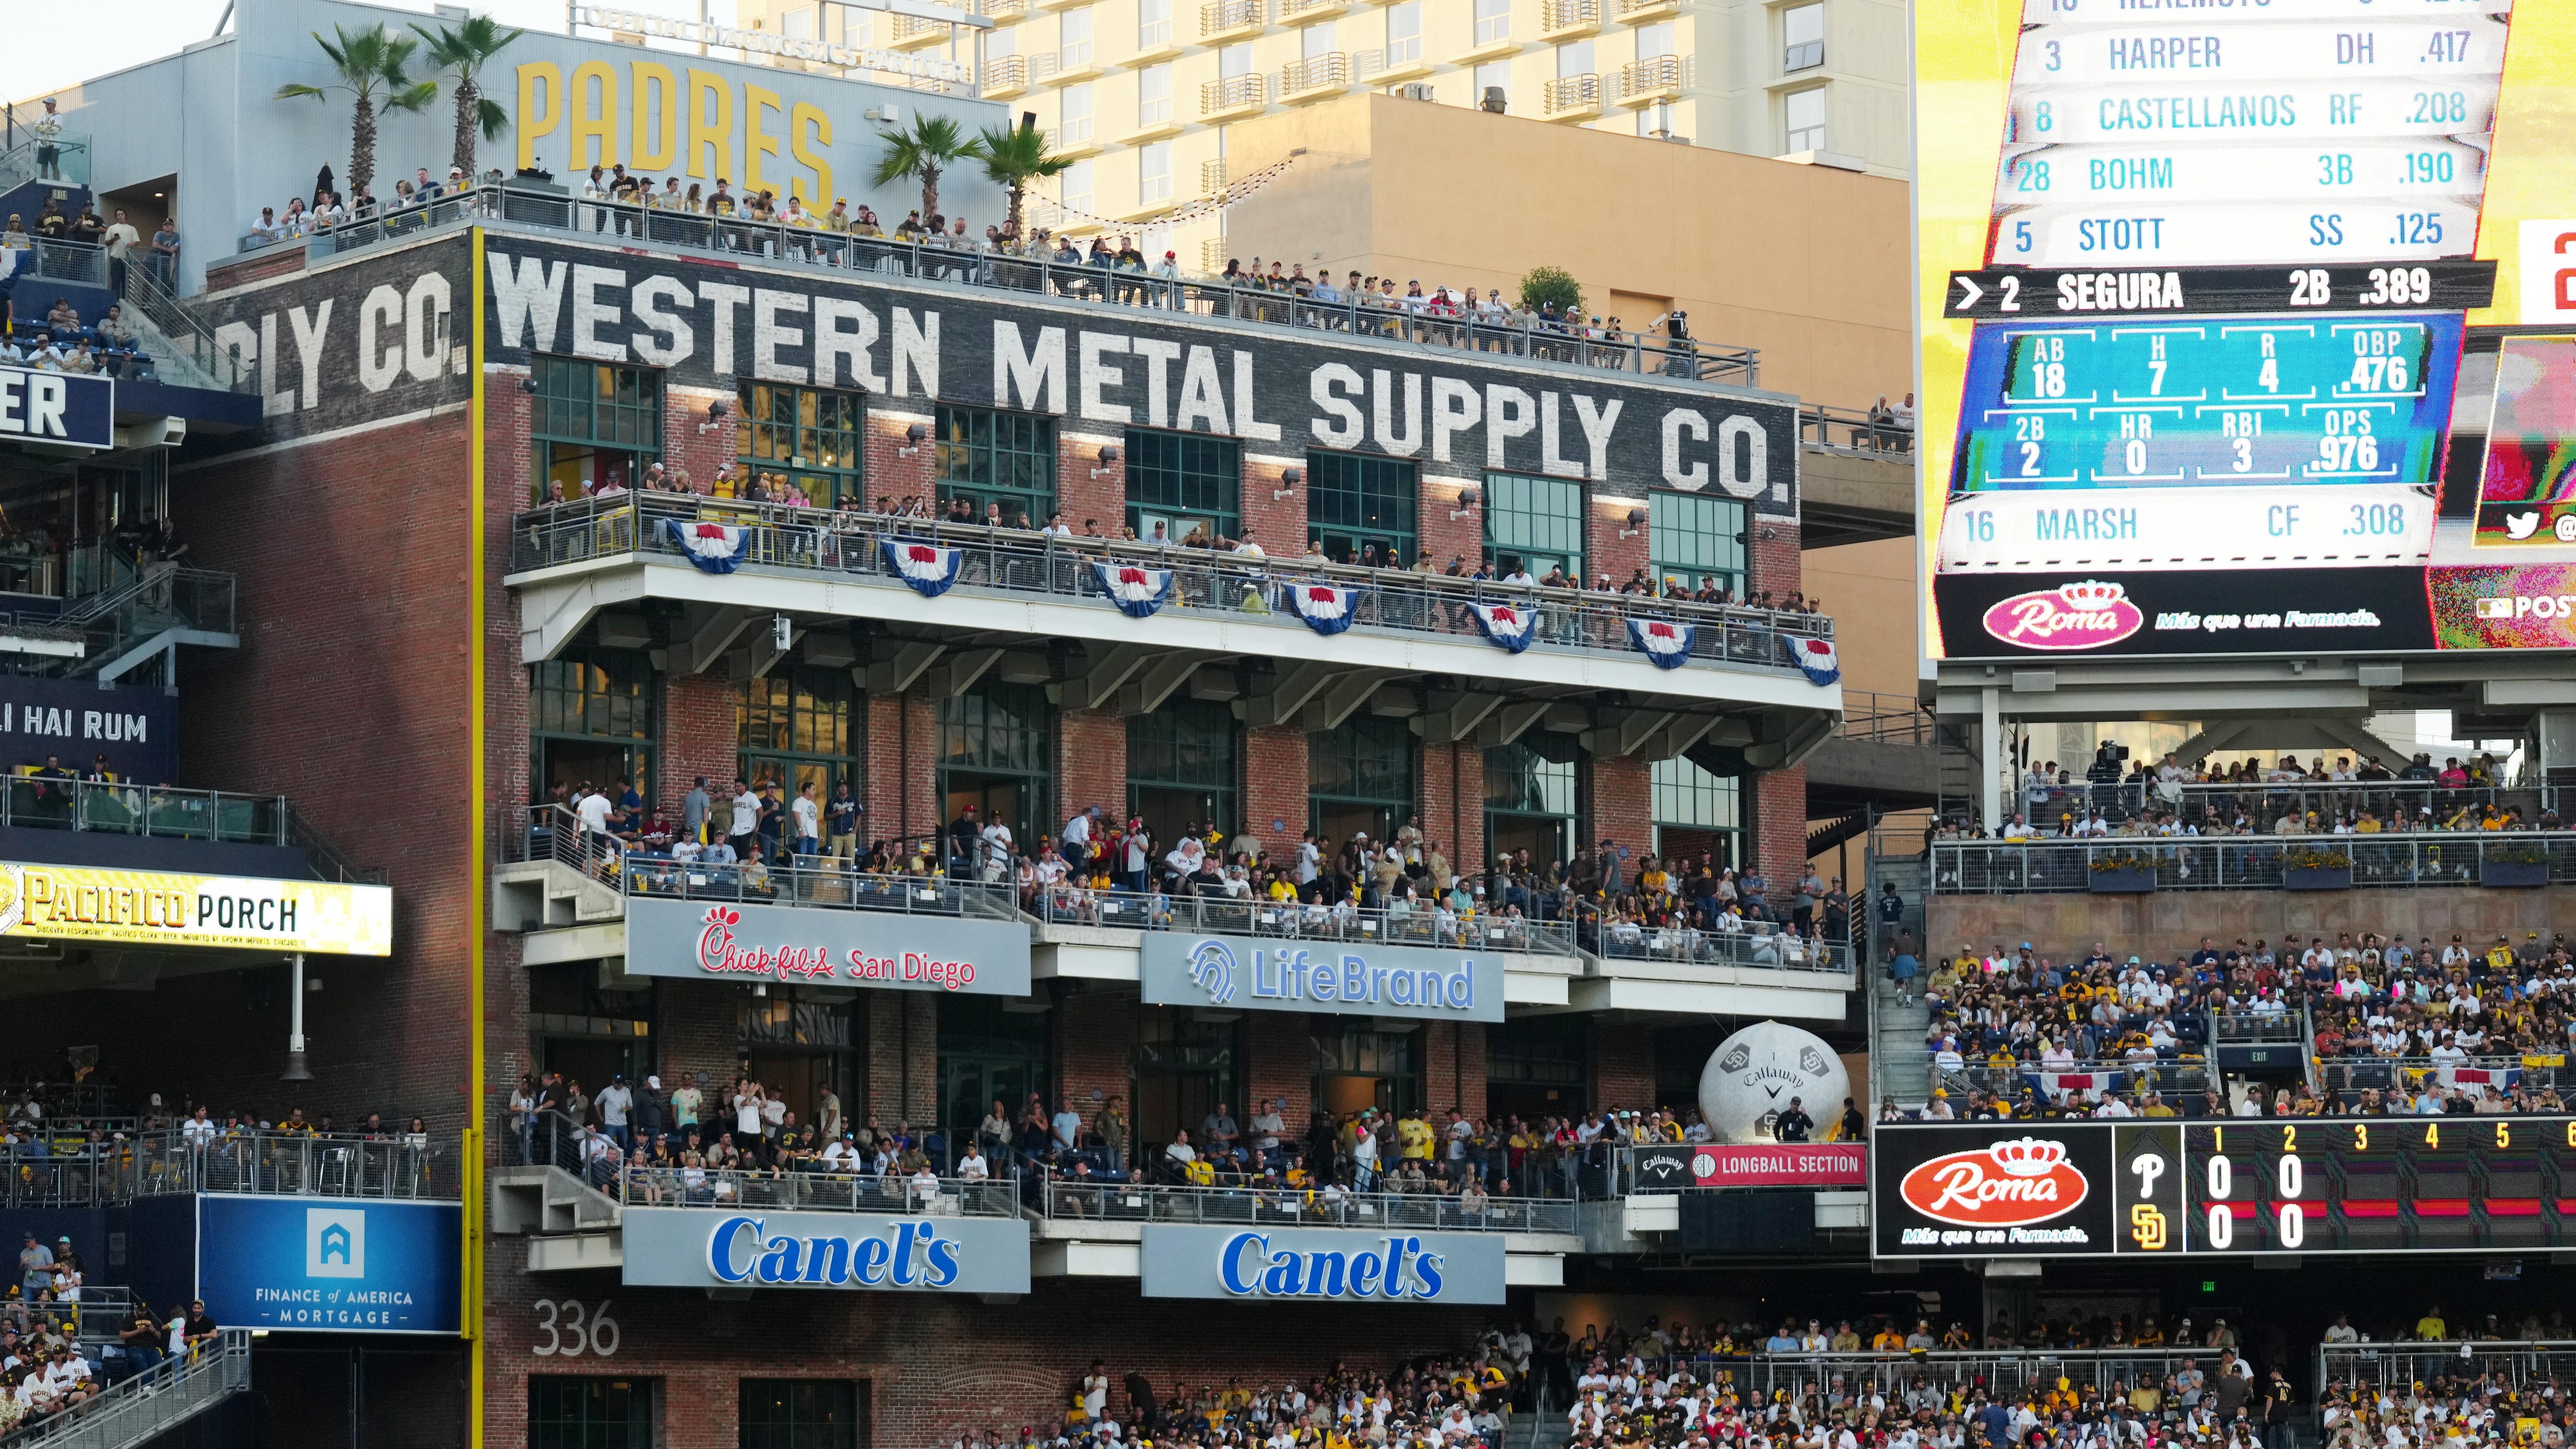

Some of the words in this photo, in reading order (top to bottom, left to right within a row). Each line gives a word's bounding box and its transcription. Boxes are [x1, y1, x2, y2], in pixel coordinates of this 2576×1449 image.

[583, 5, 696, 42] OFFICIAL
[700, 23, 858, 67] DIAGNOSTICS
[863, 47, 967, 82] PARTNER
[2045, 40, 2061, 72] 3
[2110, 36, 2221, 70] HARPER
[2335, 31, 2374, 65] DH
[2420, 30, 2472, 63] .417
[2036, 100, 2052, 132] 8
[2099, 94, 2296, 131] CASTELLANOS
[2330, 93, 2363, 125] RF
[2405, 91, 2467, 124] .208
[517, 60, 832, 221] PADRES
[2018, 160, 2050, 192] 28
[2090, 157, 2174, 190] BOHM
[2318, 153, 2354, 186] 3B
[2398, 151, 2453, 183] .190
[2015, 220, 2032, 253] 5
[2078, 217, 2165, 251] STOTT
[2309, 214, 2343, 245] SS
[2388, 212, 2444, 245] .125
[2000, 276, 2021, 312] 2
[2057, 271, 2184, 310] SEGURA
[2289, 269, 2331, 305] 2B
[2359, 268, 2431, 304] .389
[2035, 337, 2064, 362] AB
[2152, 335, 2165, 360] H
[2262, 333, 2276, 358] R
[2353, 330, 2401, 355] OBP
[486, 251, 940, 399] WESTERN
[993, 318, 1281, 442] METAL
[1310, 360, 1624, 481] SUPPLY
[1660, 405, 1789, 504] CO.
[2033, 364, 2066, 397] 18
[2148, 361, 2167, 395] 7
[2259, 359, 2279, 393] 4
[2342, 357, 2408, 391] .476
[2015, 416, 2044, 441] 2B
[2121, 414, 2151, 439] HR
[2223, 412, 2262, 437] RBI
[2325, 410, 2371, 435] OPS
[2021, 442, 2041, 476] 2
[2127, 440, 2146, 474] 0
[2233, 438, 2252, 472] 3
[2313, 437, 2379, 471] .976
[1965, 510, 1994, 543] 16
[2036, 507, 2137, 540] MARSH
[2267, 505, 2300, 536] CF
[2342, 504, 2404, 536] .308
[2008, 599, 2117, 638] Roma
[2155, 611, 2200, 629] Más
[2203, 612, 2240, 632] que
[2244, 612, 2280, 629] una
[2516, 595, 2576, 618] POS
[24, 705, 72, 737] HAI
[84, 710, 146, 742] RUM
[198, 894, 297, 933] PORCH
[697, 905, 835, 981] Chick-fil-A
[846, 948, 895, 981] San
[900, 951, 977, 992] Diego
[1251, 947, 1475, 1009] LifeBrand
[1772, 1052, 1776, 1061] 1
[2252, 1052, 2266, 1062] EXIT
[1743, 1065, 1804, 1088] Callaway
[2214, 1126, 2223, 1152] 1
[2284, 1126, 2296, 1151] 2
[2355, 1124, 2367, 1150] 3
[2426, 1123, 2438, 1149] 4
[2497, 1122, 2510, 1148] 5
[1642, 1154, 1685, 1171] Callaway
[1722, 1156, 1795, 1174] LONGBALL
[1799, 1155, 1858, 1173] SECTION
[2131, 1152, 2165, 1199] P
[2208, 1154, 2231, 1199] 0
[2279, 1154, 2302, 1199] 0
[1930, 1162, 2059, 1212] Roma
[1902, 1226, 1938, 1244] Más
[1941, 1229, 1971, 1246] que
[1975, 1229, 2006, 1243] una
[2009, 1225, 2089, 1243] Farmacia.
[2209, 1204, 2231, 1249] 0
[2279, 1203, 2302, 1249] 0
[706, 1216, 961, 1289] Canel's
[1217, 1232, 1445, 1300] Canel's
[256, 1288, 320, 1302] FINANCE
[328, 1289, 341, 1303] of
[347, 1291, 413, 1305] AMERICA
[2203, 1281, 2215, 1292] EXIT
[280, 1309, 391, 1324] MORTGAGE
[531, 1298, 620, 1357] 336
